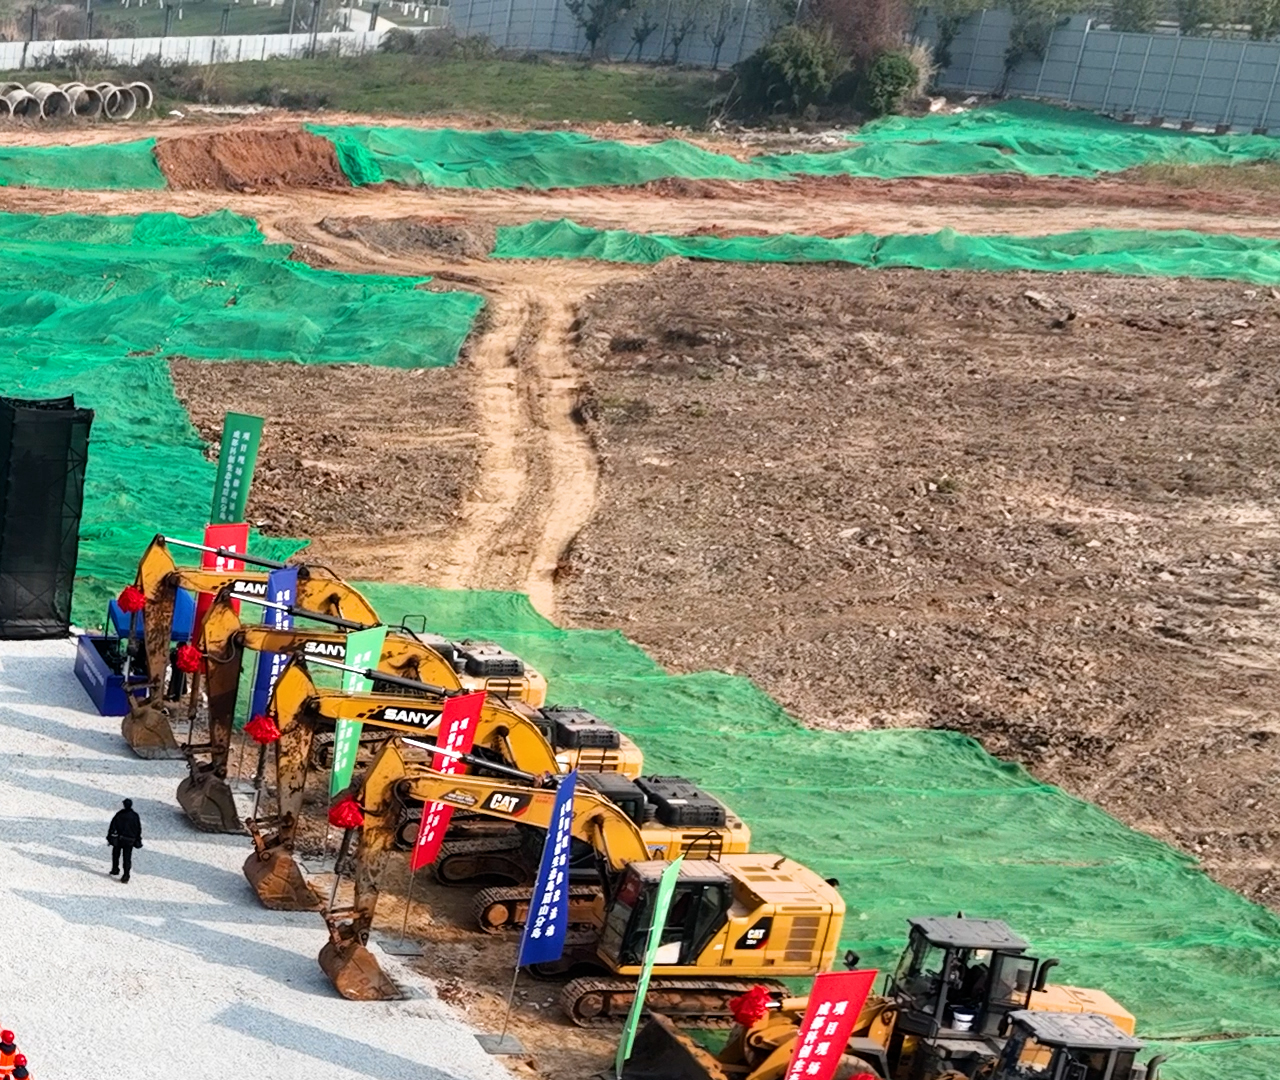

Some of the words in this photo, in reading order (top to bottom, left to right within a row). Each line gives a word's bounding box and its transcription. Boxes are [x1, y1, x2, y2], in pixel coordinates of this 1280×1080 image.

[234, 580, 270, 597] SAN
[304, 641, 346, 657] SANY
[383, 708, 435, 726] SANY
[490, 793, 520, 813] CAT
[747, 929, 766, 939] CAT
